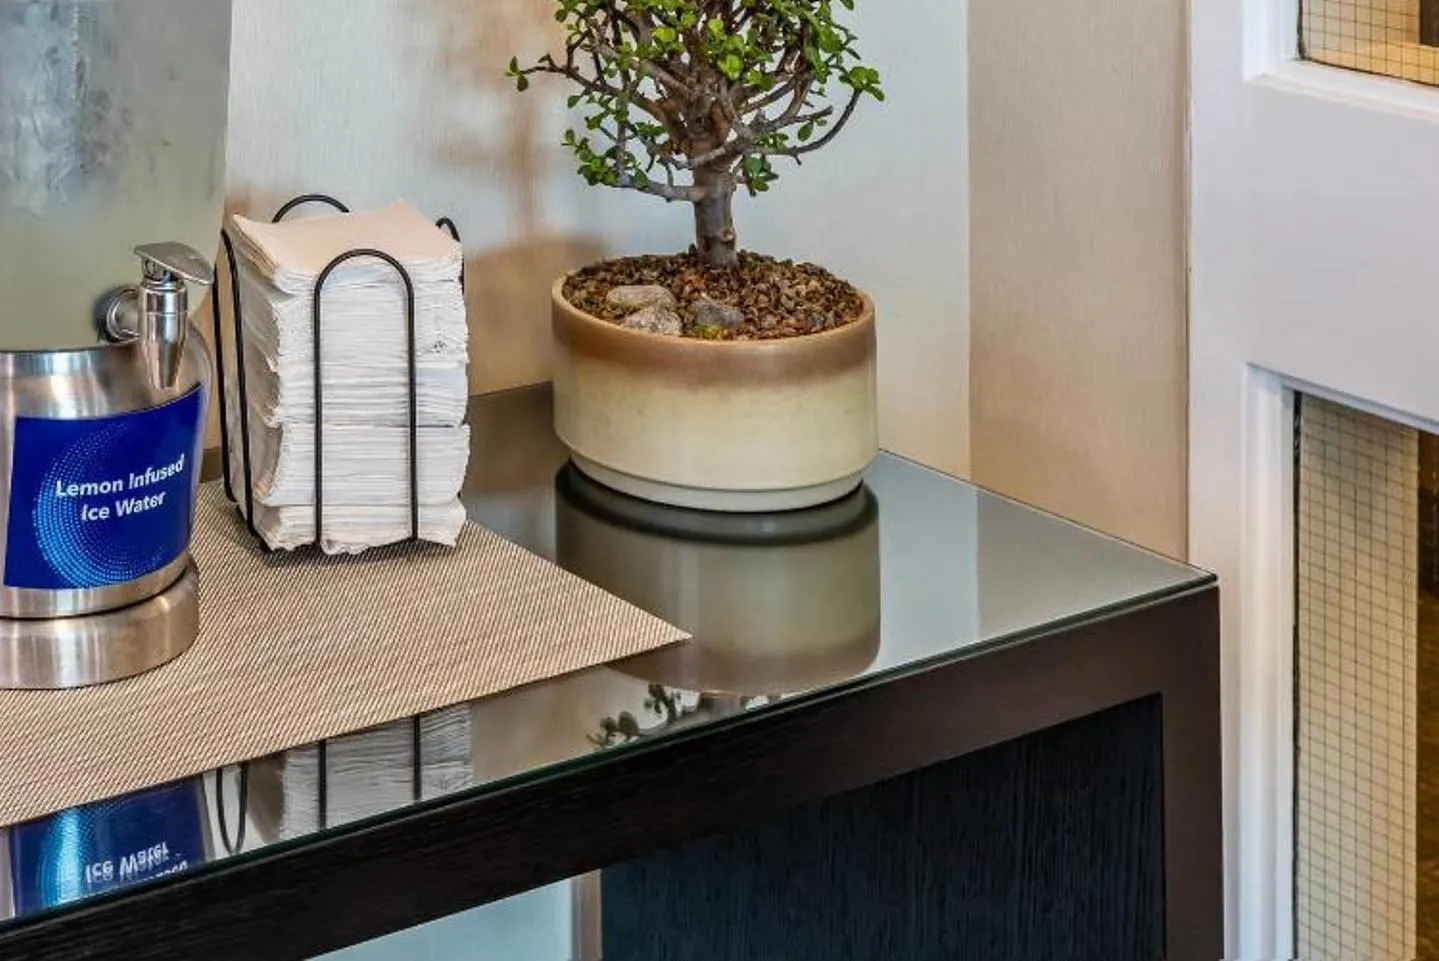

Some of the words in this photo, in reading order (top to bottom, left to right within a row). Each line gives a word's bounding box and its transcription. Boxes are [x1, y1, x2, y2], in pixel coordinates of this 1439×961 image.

[56, 480, 123, 497] Lemon
[129, 453, 185, 490] Infused
[81, 504, 110, 521] Ice
[115, 491, 166, 518] Water
